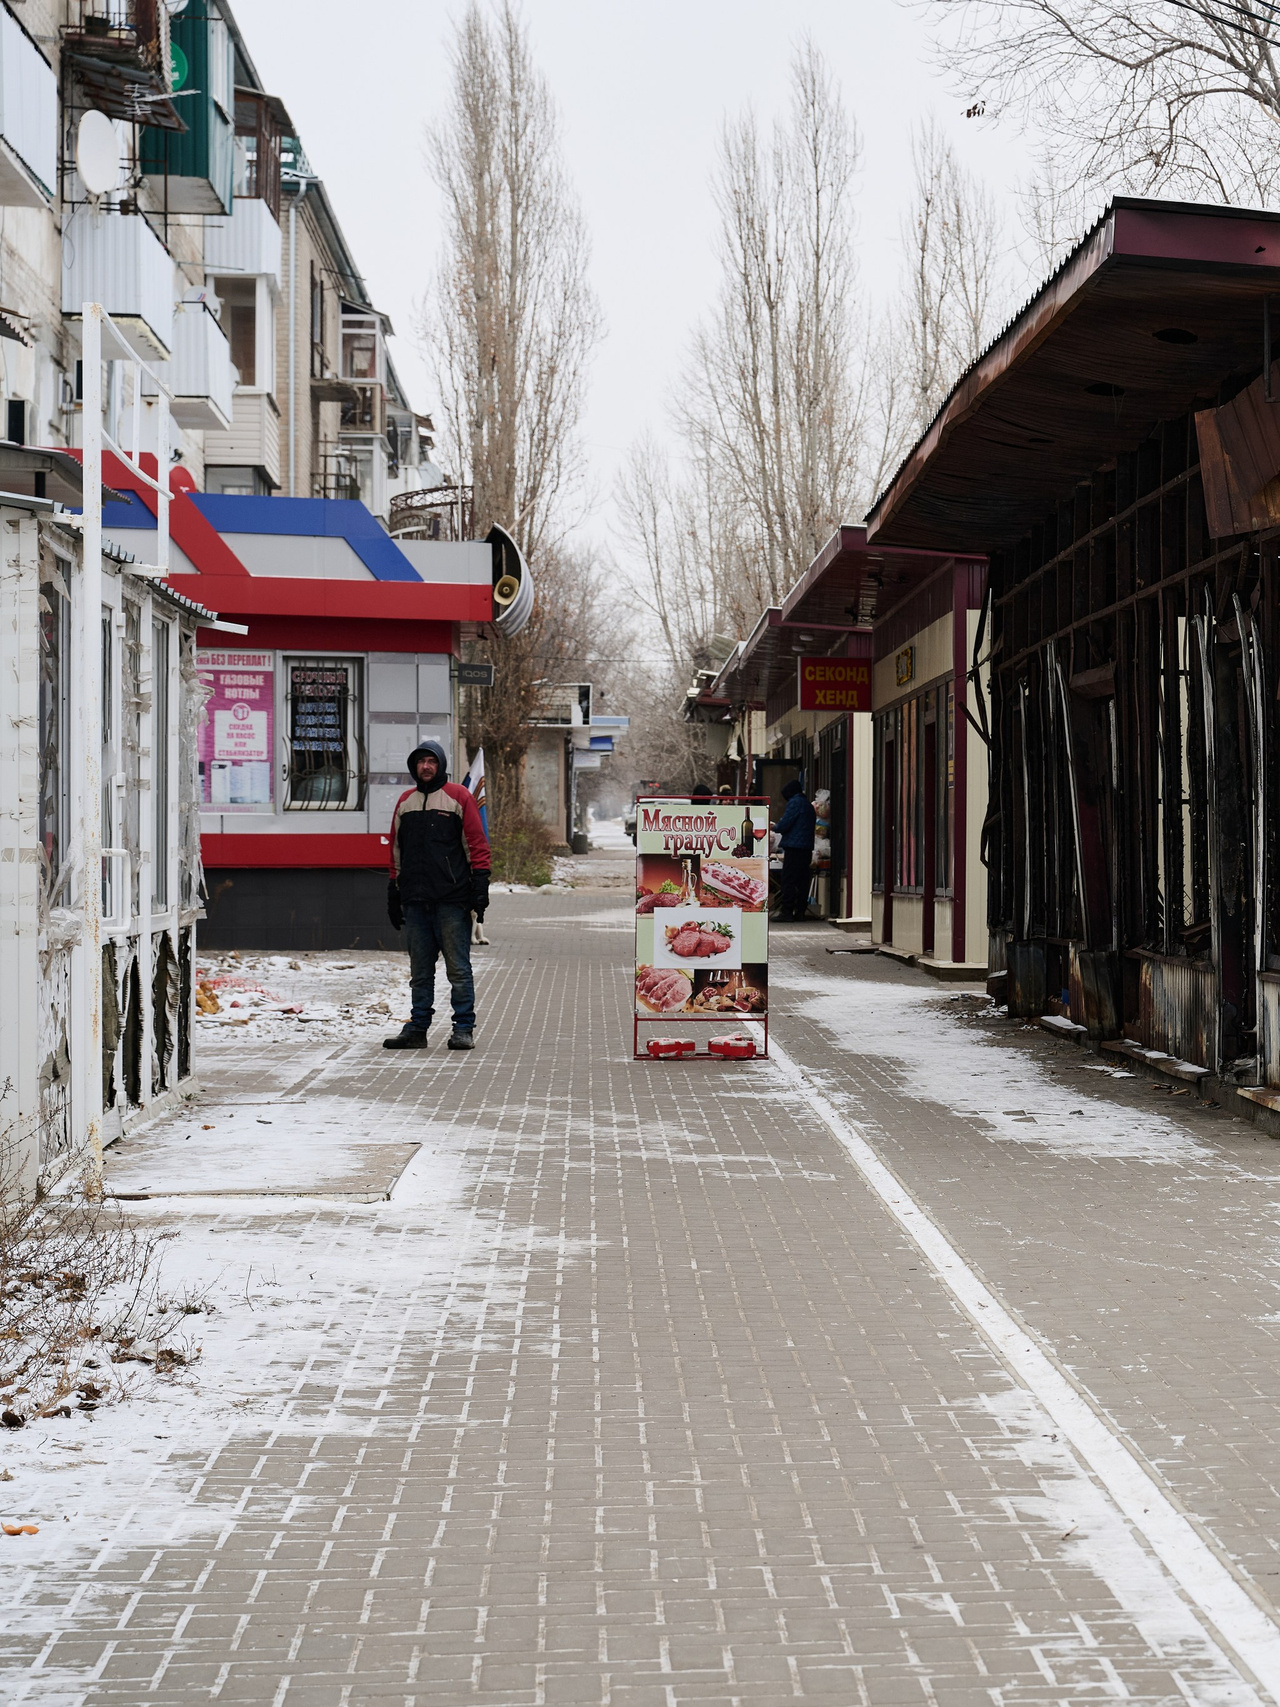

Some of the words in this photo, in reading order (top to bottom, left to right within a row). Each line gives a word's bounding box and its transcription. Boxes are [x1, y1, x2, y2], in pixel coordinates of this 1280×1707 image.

[211, 654, 225, 666] БЕЗ
[220, 674, 264, 686] ГАЗОВЫЕ
[462, 670, 488, 678] IQOS
[805, 665, 869, 684] СЕКОНД
[224, 687, 260, 699] КОТЛЫ
[815, 689, 858, 708] ХЕНД
[641, 808, 717, 832] Мясной
